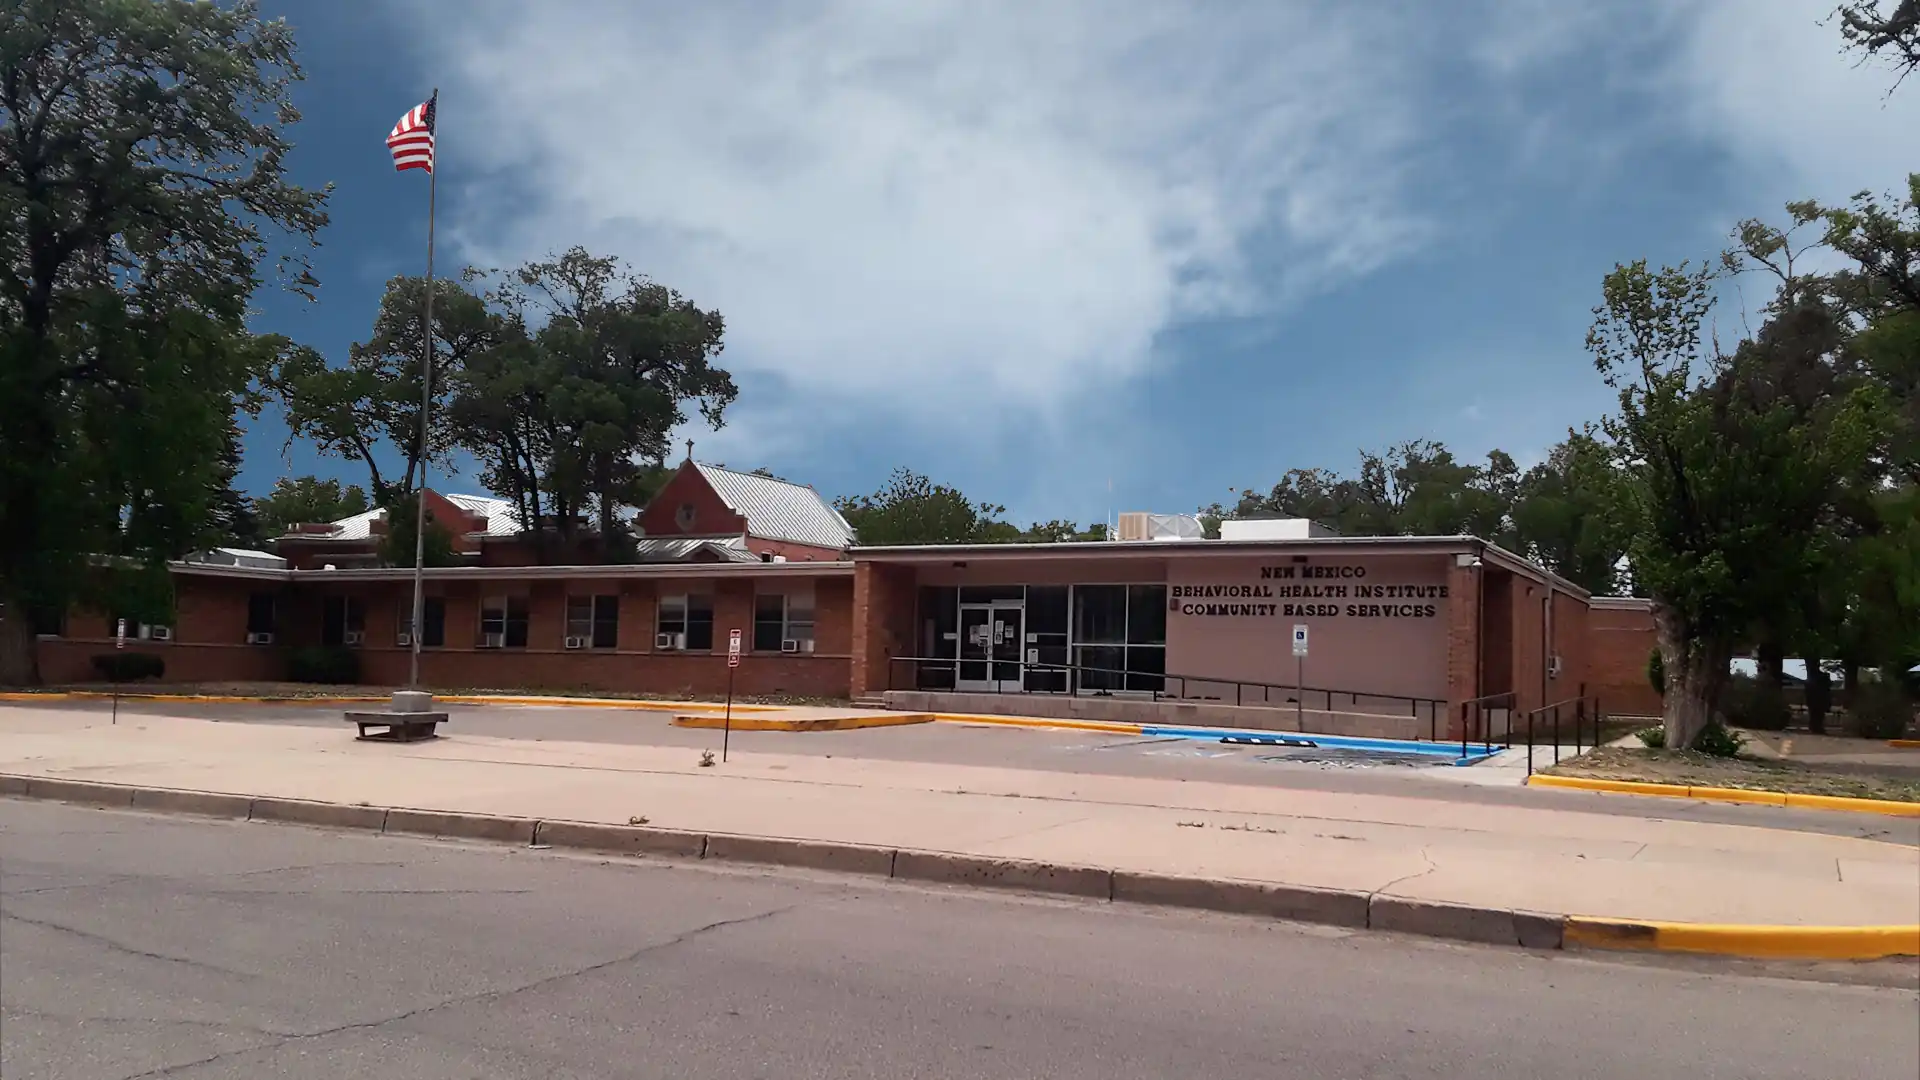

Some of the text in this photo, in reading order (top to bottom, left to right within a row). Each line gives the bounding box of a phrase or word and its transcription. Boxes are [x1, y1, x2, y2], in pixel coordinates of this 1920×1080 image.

[1260, 566, 1366, 579] NEW MEXICO
[1172, 585, 1449, 598] BEHAVIORAL HEALTH INSTITUTE
[1182, 604, 1436, 617] COMMUNITY BASED SERVICES
